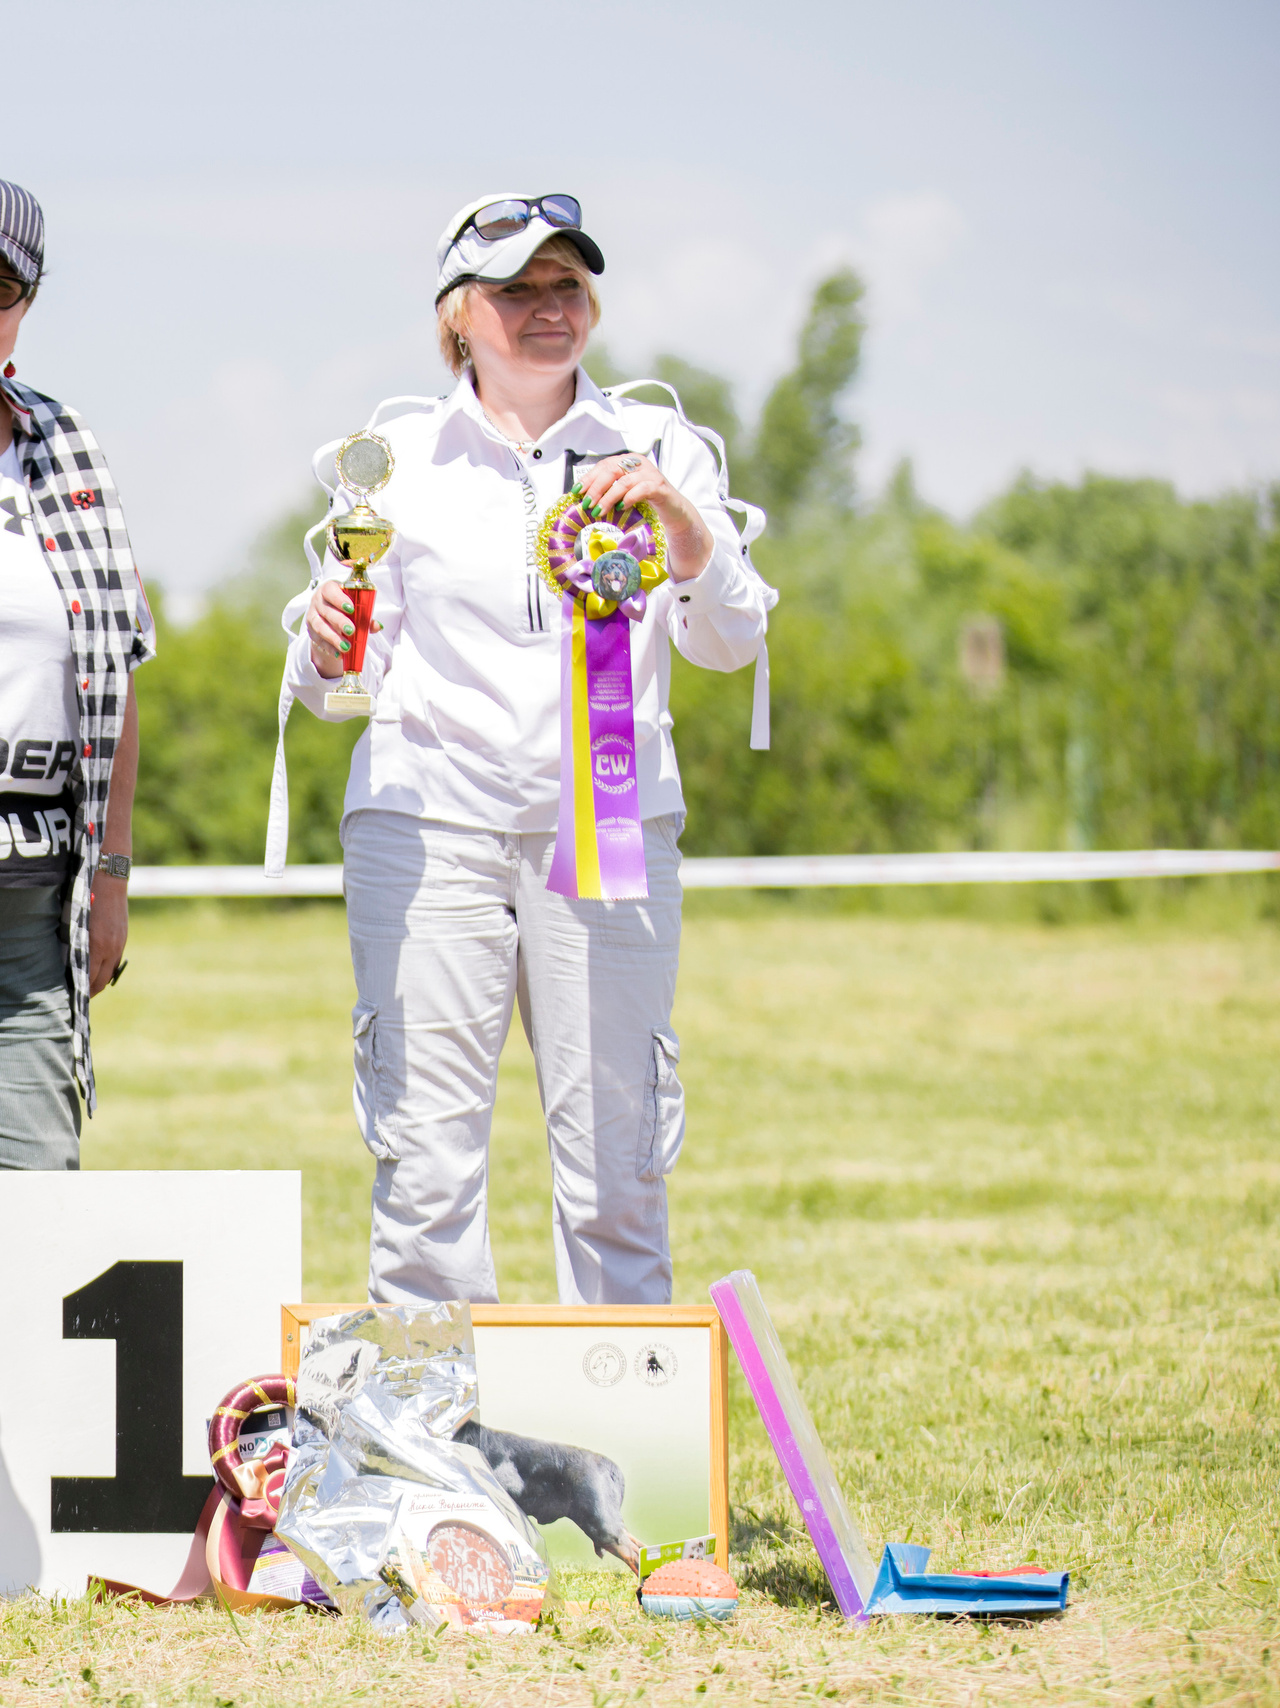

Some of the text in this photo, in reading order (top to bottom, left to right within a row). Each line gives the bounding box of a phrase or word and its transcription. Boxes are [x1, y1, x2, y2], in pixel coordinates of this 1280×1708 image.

[520, 475, 538, 516] MON
[596, 754, 630, 776] CW
[51, 1259, 216, 1533] 1
